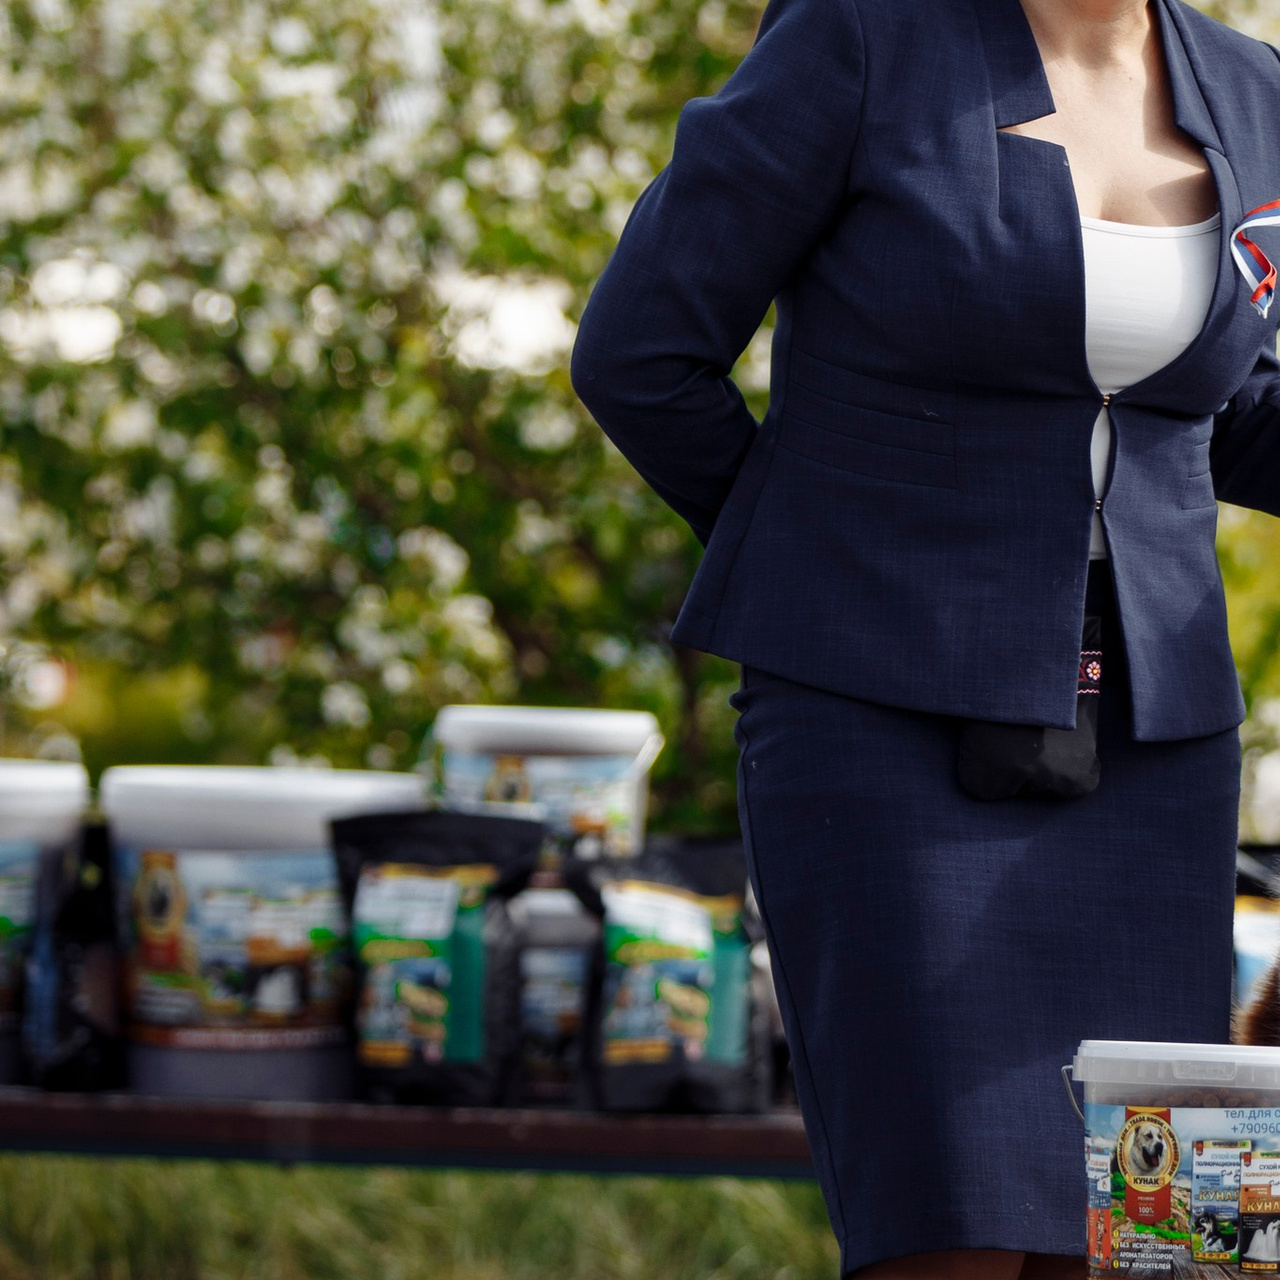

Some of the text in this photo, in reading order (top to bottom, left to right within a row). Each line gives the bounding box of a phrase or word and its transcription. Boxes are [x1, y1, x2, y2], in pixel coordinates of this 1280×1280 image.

[1133, 1176, 1160, 1185] КУНАК
[1138, 1206, 1155, 1214] 100%
[1132, 1242, 1186, 1250] ИСКУССТВЕННЫХ
[1120, 1252, 1173, 1260] АРОМАТИЗАТОРОВ
[1132, 1262, 1171, 1270] КРАСИТЕЛЕЙ
